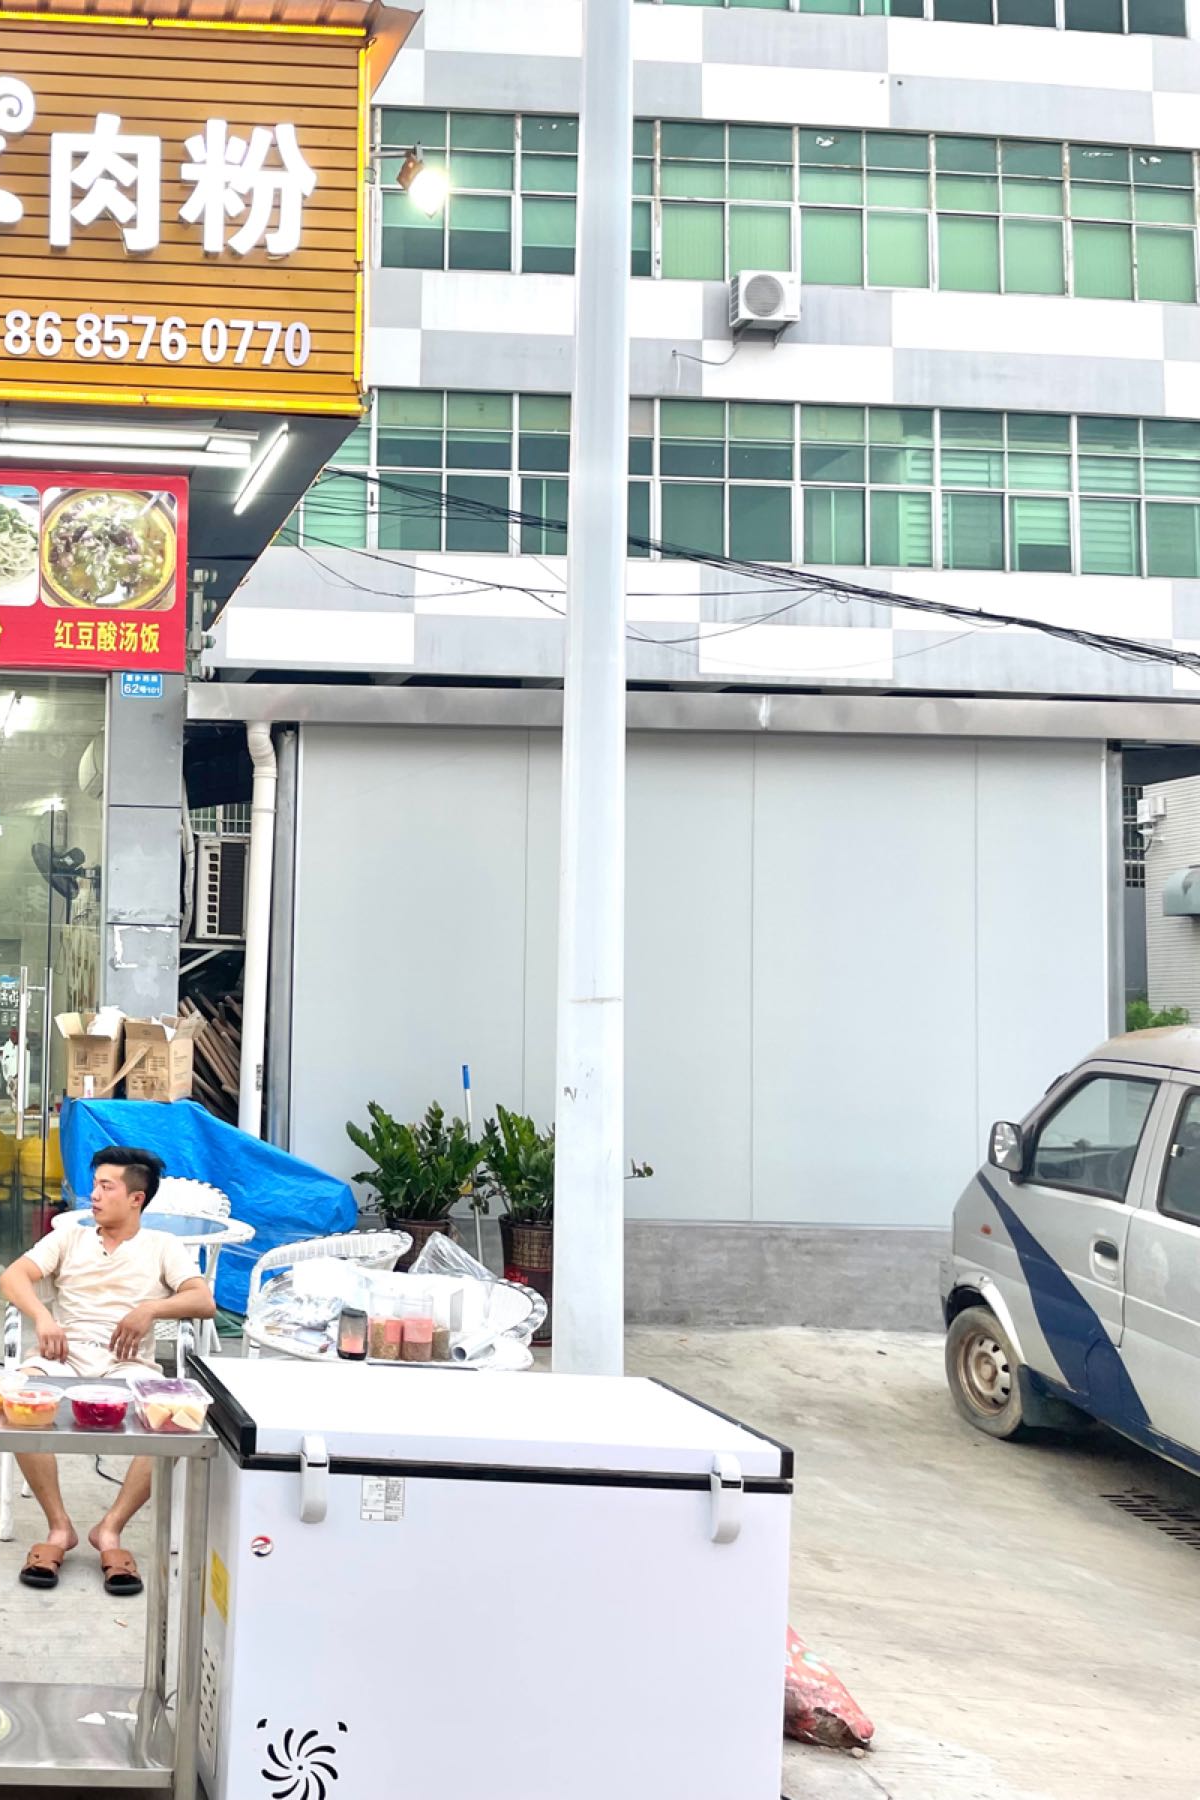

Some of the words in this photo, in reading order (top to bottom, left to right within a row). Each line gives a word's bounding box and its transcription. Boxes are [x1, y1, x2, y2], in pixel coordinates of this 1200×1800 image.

[74, 314, 188, 362] 8576
[201, 318, 311, 367] 0770
[54, 620, 160, 654] 红豆酸汤饭
